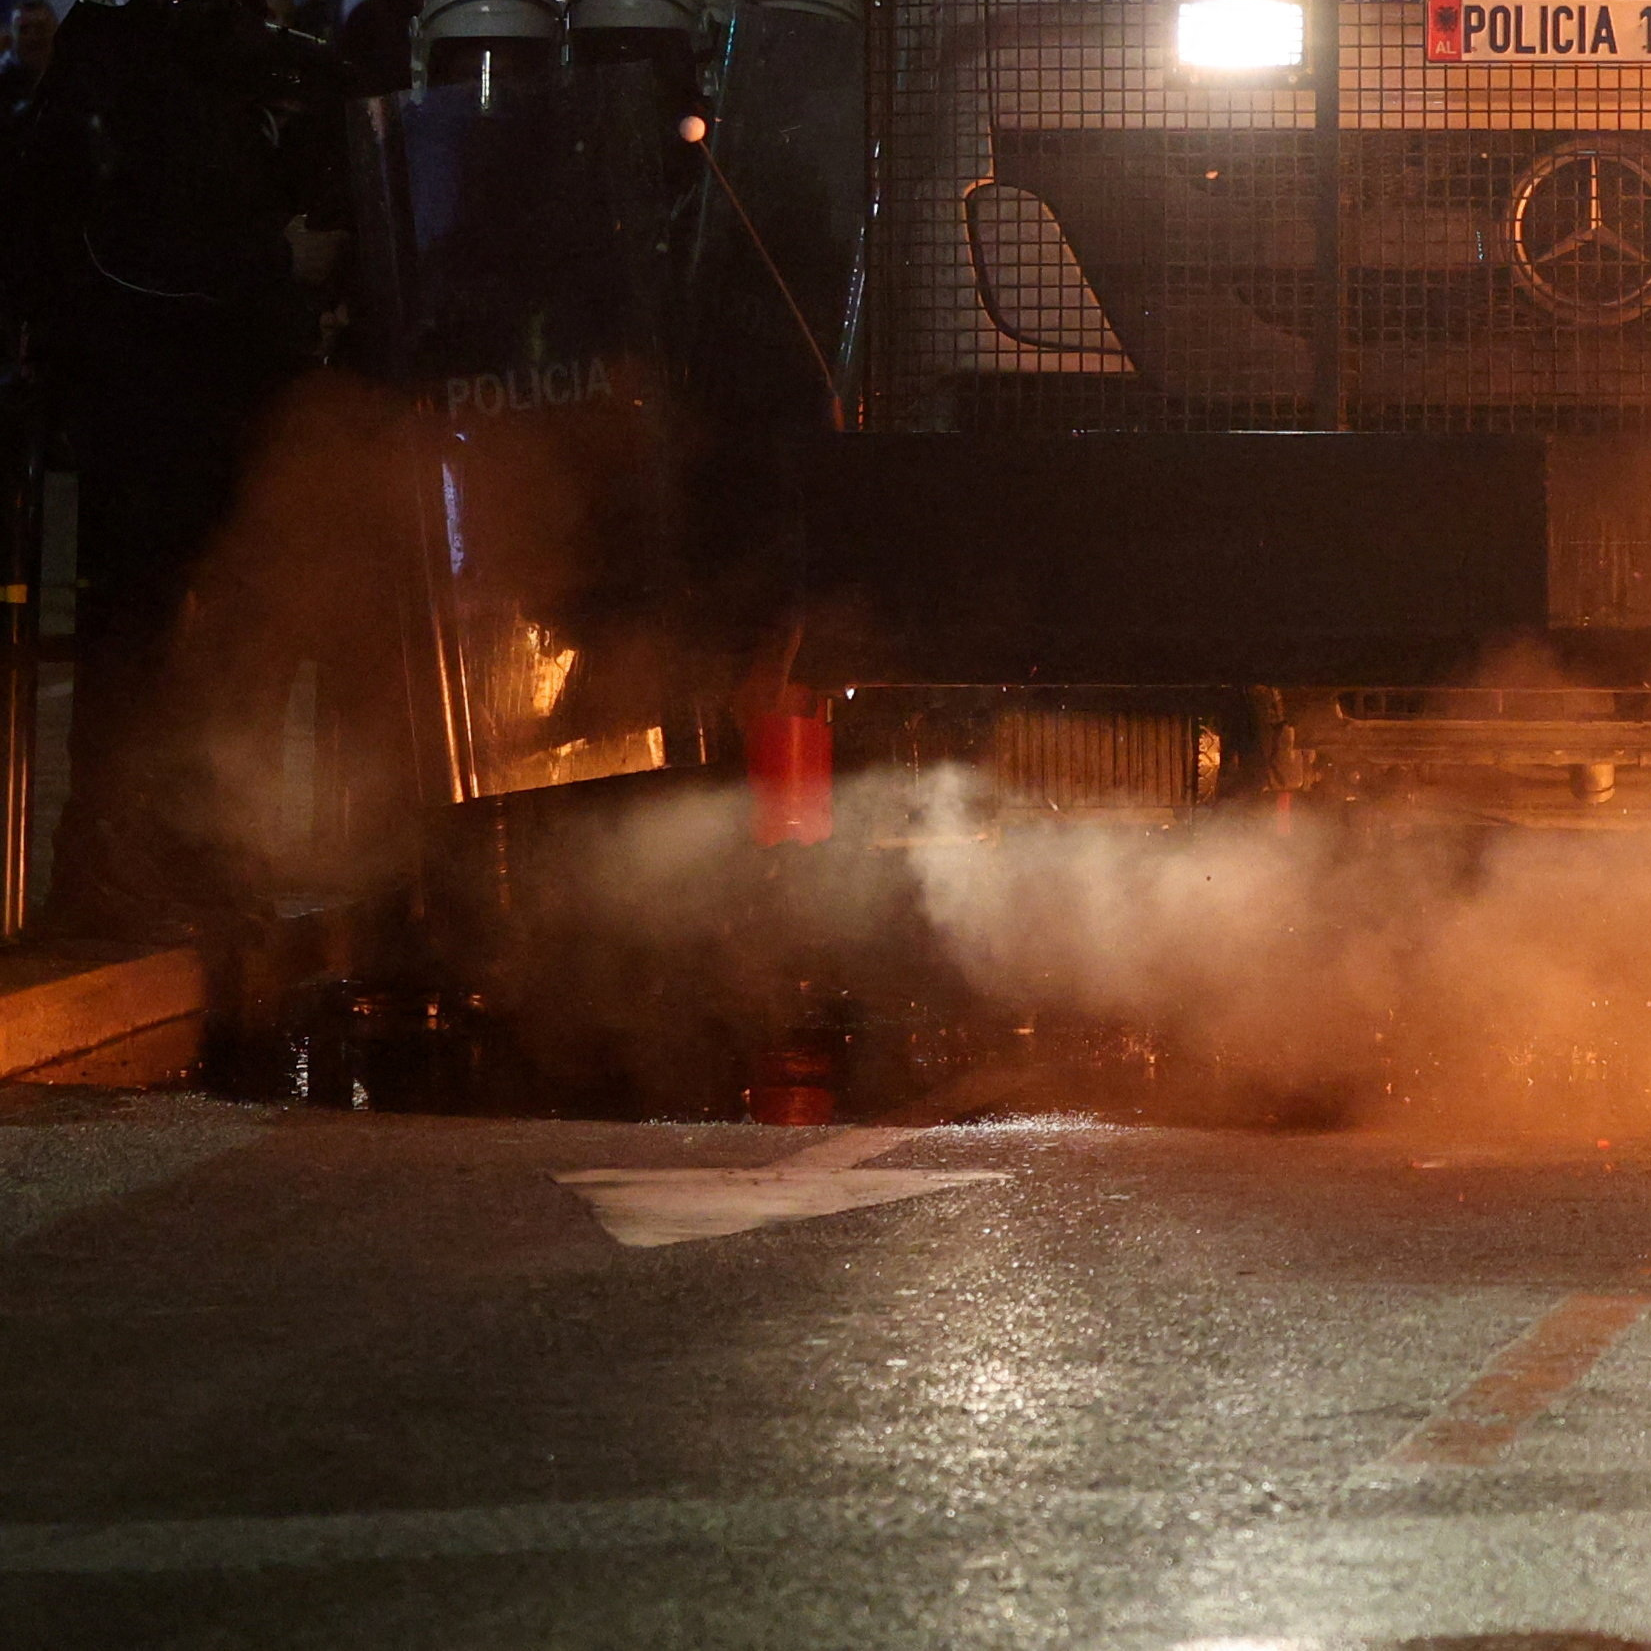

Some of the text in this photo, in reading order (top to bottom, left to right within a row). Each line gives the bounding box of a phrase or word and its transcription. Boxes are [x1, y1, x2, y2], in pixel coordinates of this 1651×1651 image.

[1435, 41, 1456, 54] AL
[1463, 5, 1617, 54] POLICIA
[447, 356, 612, 418] POLICIA
